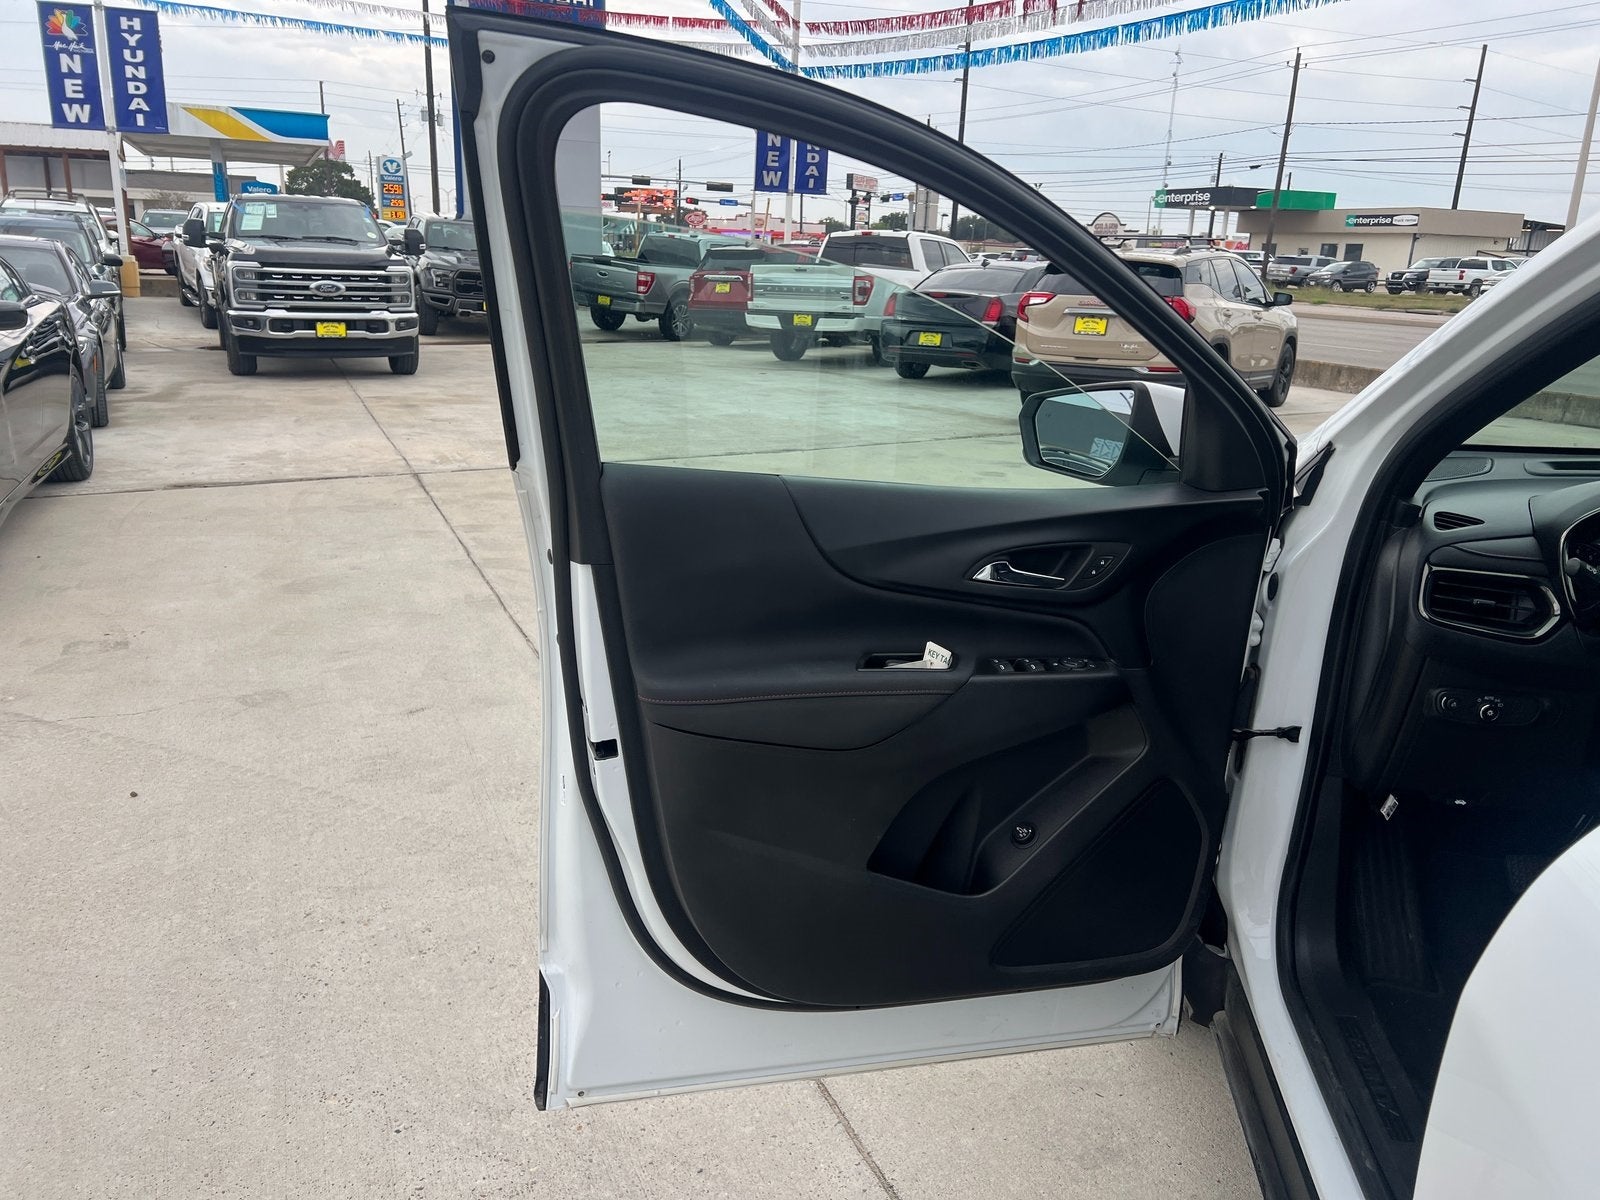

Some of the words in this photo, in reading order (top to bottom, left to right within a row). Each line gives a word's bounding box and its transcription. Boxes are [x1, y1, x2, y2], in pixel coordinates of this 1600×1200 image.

[119, 16, 150, 127] HYUNDAI
[59, 53, 91, 124] NEW
[762, 132, 783, 187] NEW
[247, 185, 272, 194] Valero
[1156, 191, 1211, 204] enterprise
[1347, 216, 1392, 226] enterprise
[319, 283, 337, 294] Ford
[928, 648, 941, 660] KEY
